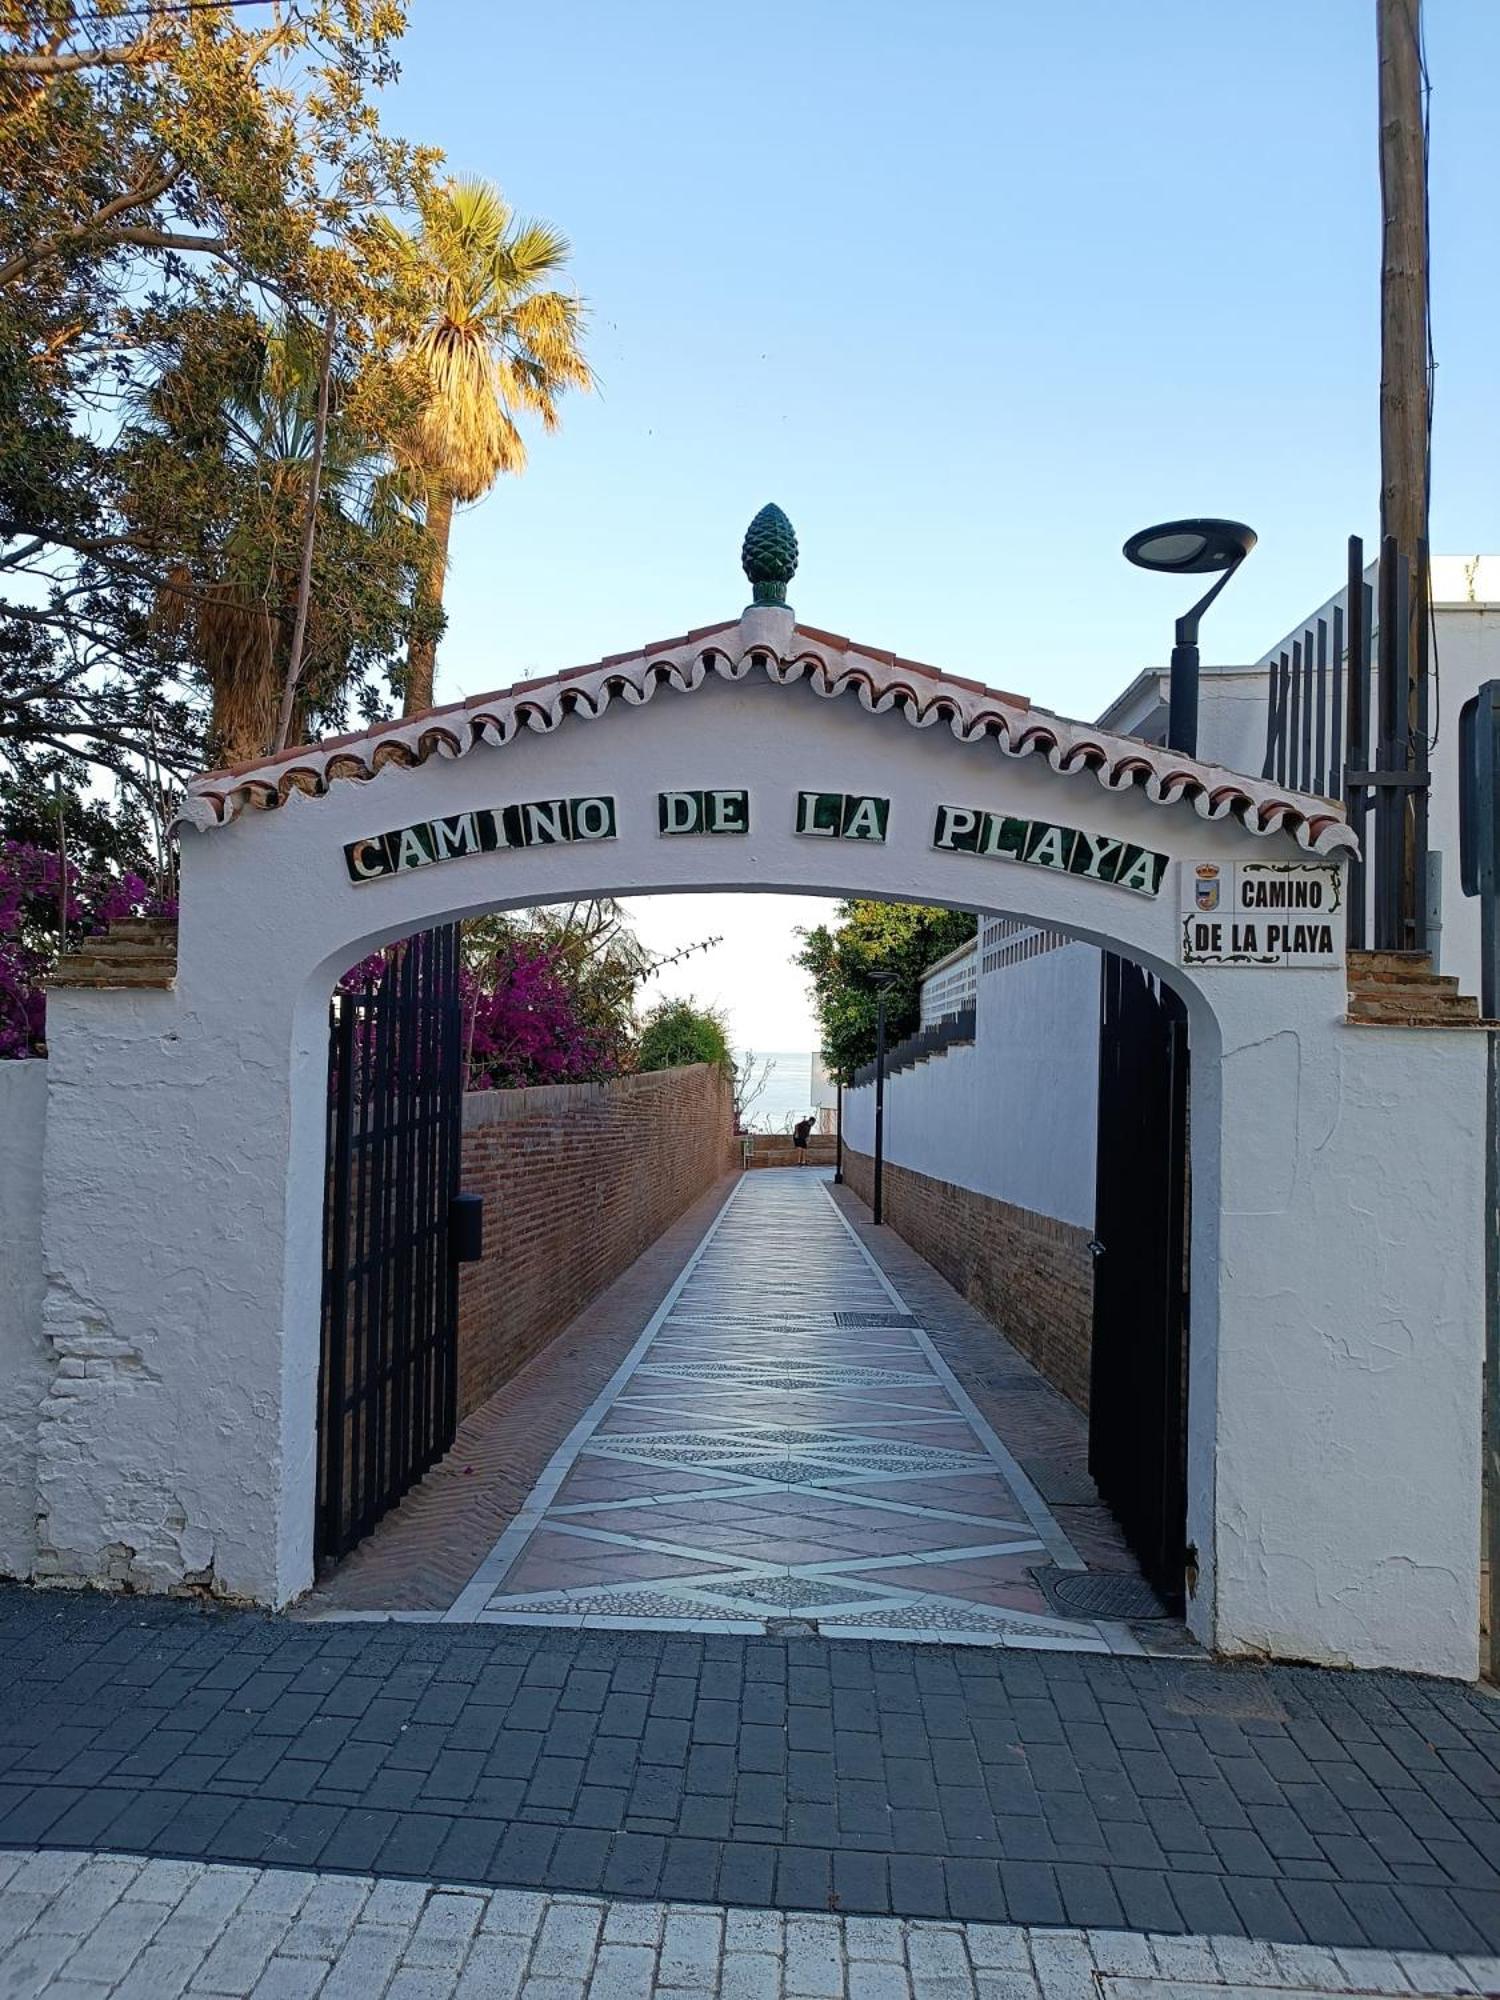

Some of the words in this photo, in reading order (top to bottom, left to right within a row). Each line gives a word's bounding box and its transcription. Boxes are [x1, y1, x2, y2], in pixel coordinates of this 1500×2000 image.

[352, 798, 611, 878] CAMINO
[664, 790, 743, 833] DE
[801, 795, 883, 841] LA
[937, 806, 1157, 893] PLAYA
[1242, 880, 1322, 908] CAMINO
[1195, 924, 1222, 951] DE
[1232, 924, 1258, 952] LA
[1267, 925, 1333, 953] PLAYA
